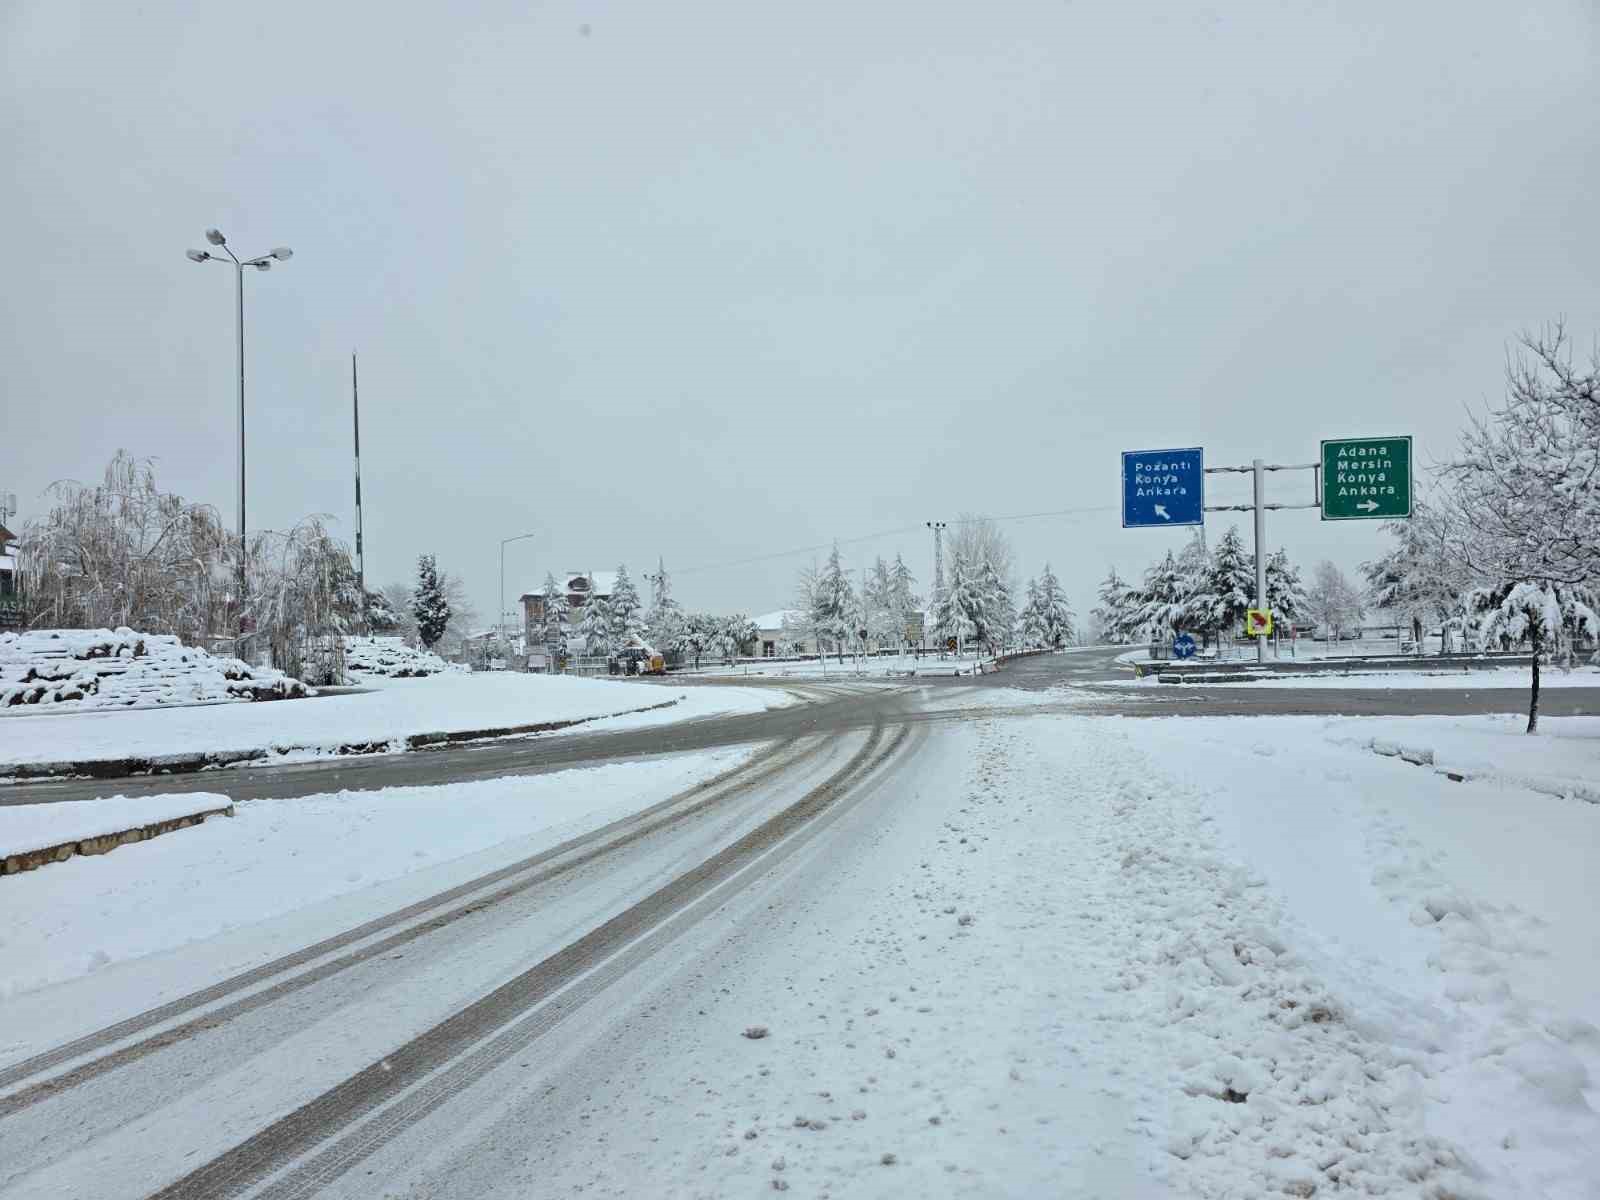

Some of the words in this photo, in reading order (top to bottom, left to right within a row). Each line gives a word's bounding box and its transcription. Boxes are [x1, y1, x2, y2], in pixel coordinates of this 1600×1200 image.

[1337, 447, 1387, 457] Adana
[1337, 458, 1392, 470] Mersin
[1135, 473, 1178, 485] Konya
[1337, 472, 1386, 484] Konya
[1136, 487, 1187, 497] Ankara
[1338, 486, 1395, 496] Ankara
